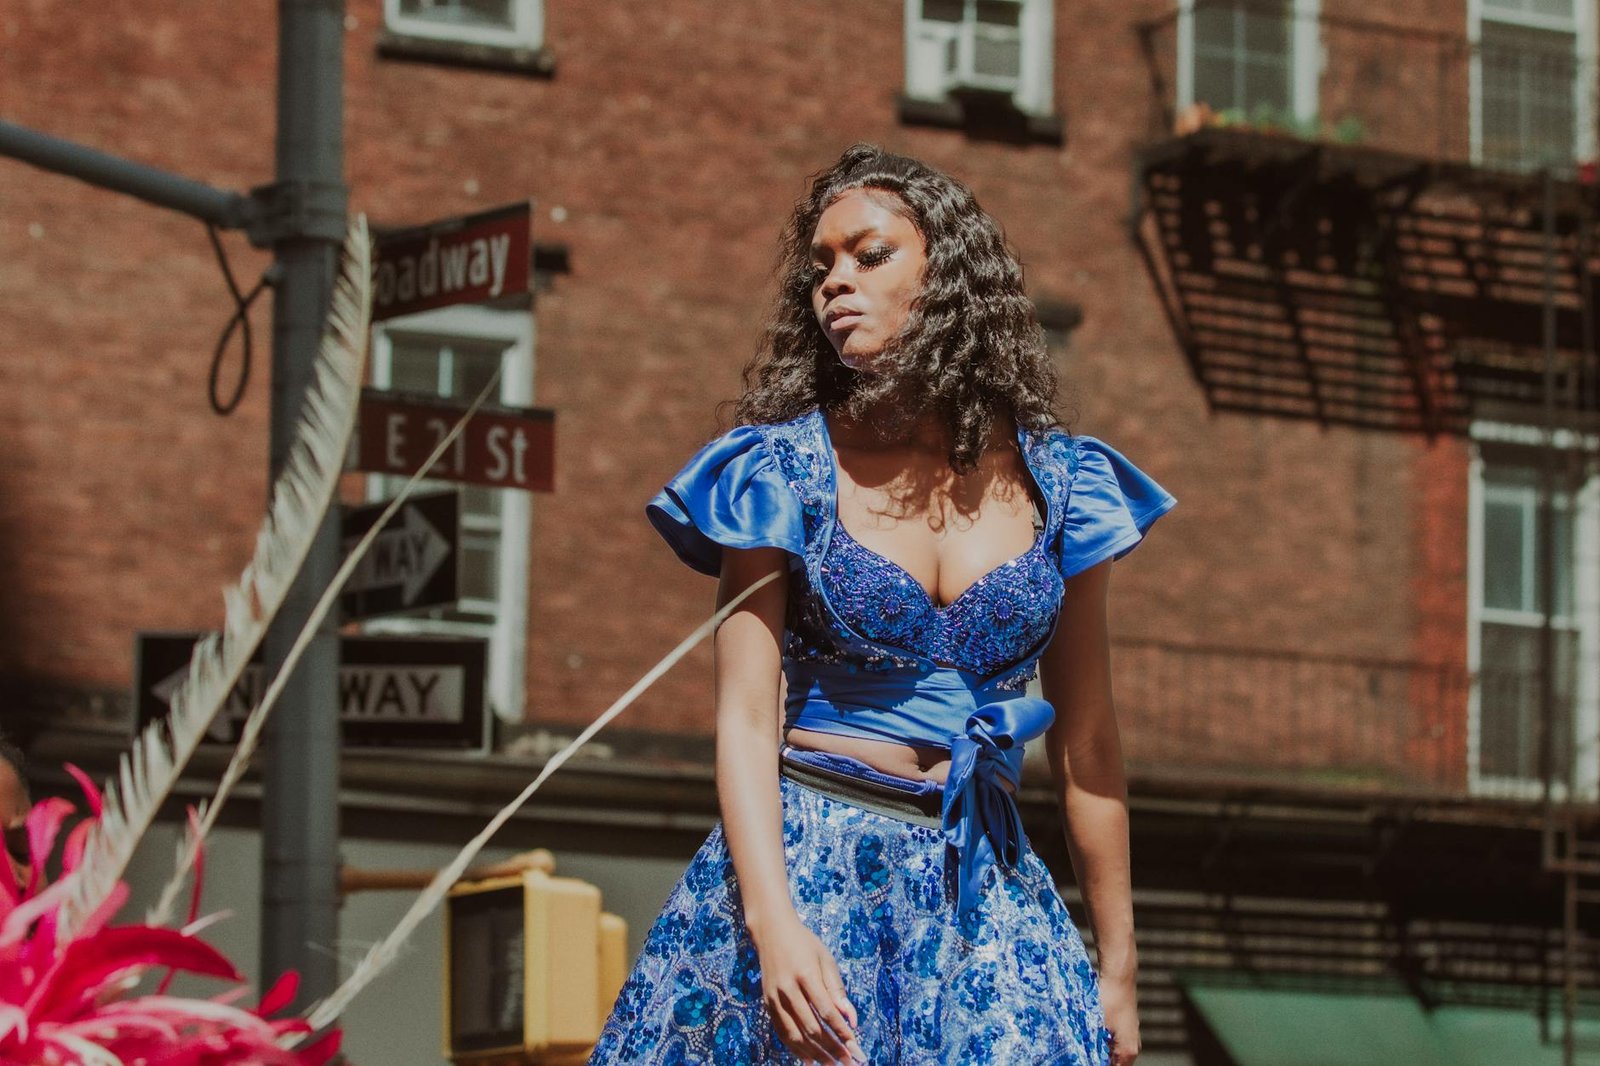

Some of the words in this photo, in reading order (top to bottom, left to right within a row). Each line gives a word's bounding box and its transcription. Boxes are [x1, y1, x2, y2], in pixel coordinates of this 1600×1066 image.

[376, 233, 510, 305] oadway
[386, 413, 407, 468] E
[425, 418, 466, 475] 21
[485, 425, 529, 484] St
[372, 530, 432, 579] WAY
[341, 671, 440, 715] WAY
